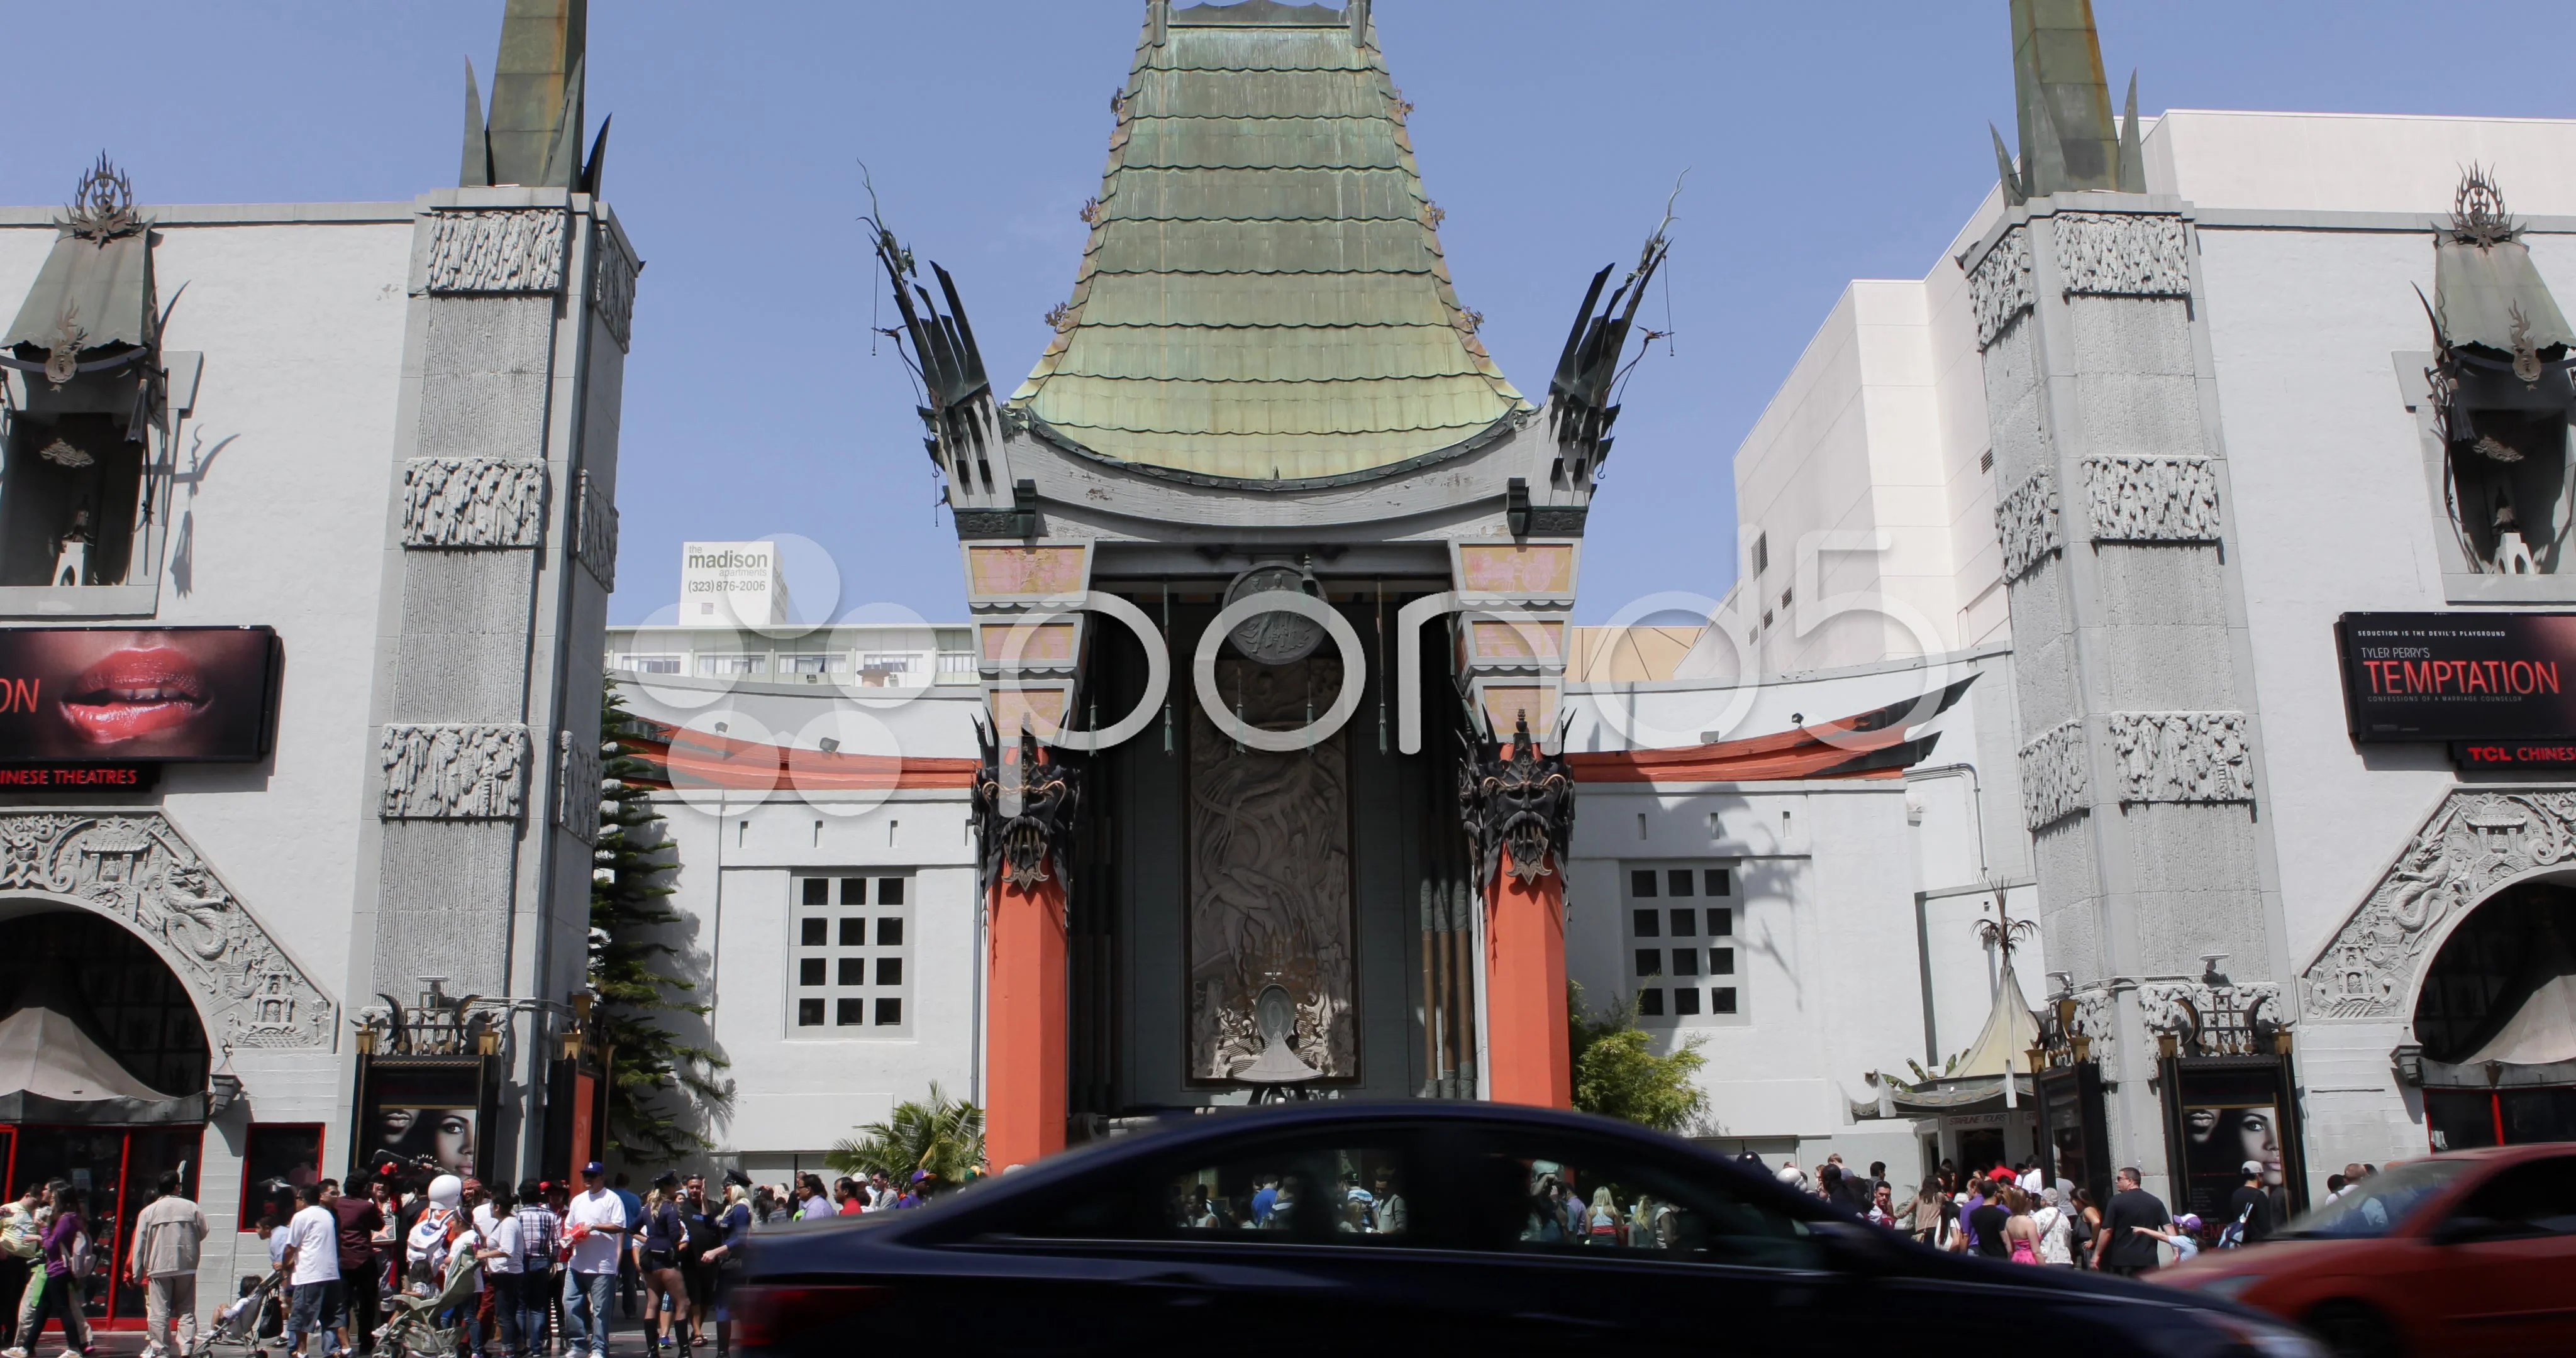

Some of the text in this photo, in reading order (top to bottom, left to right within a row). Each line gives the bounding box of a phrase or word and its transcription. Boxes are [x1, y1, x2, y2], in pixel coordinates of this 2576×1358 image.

[689, 545, 702, 553] the
[689, 549, 767, 568] madison
[719, 568, 767, 578] apartments
[688, 579, 765, 593] (323) 876-2006
[2361, 648, 2431, 658] TYLER PERRY'S
[2363, 661, 2560, 694] TEMPTATION
[2467, 746, 2576, 761] TCL CHINES
[53, 768, 137, 784] THEATRES
[1949, 1113, 2007, 1125] STARLINE TOURS
